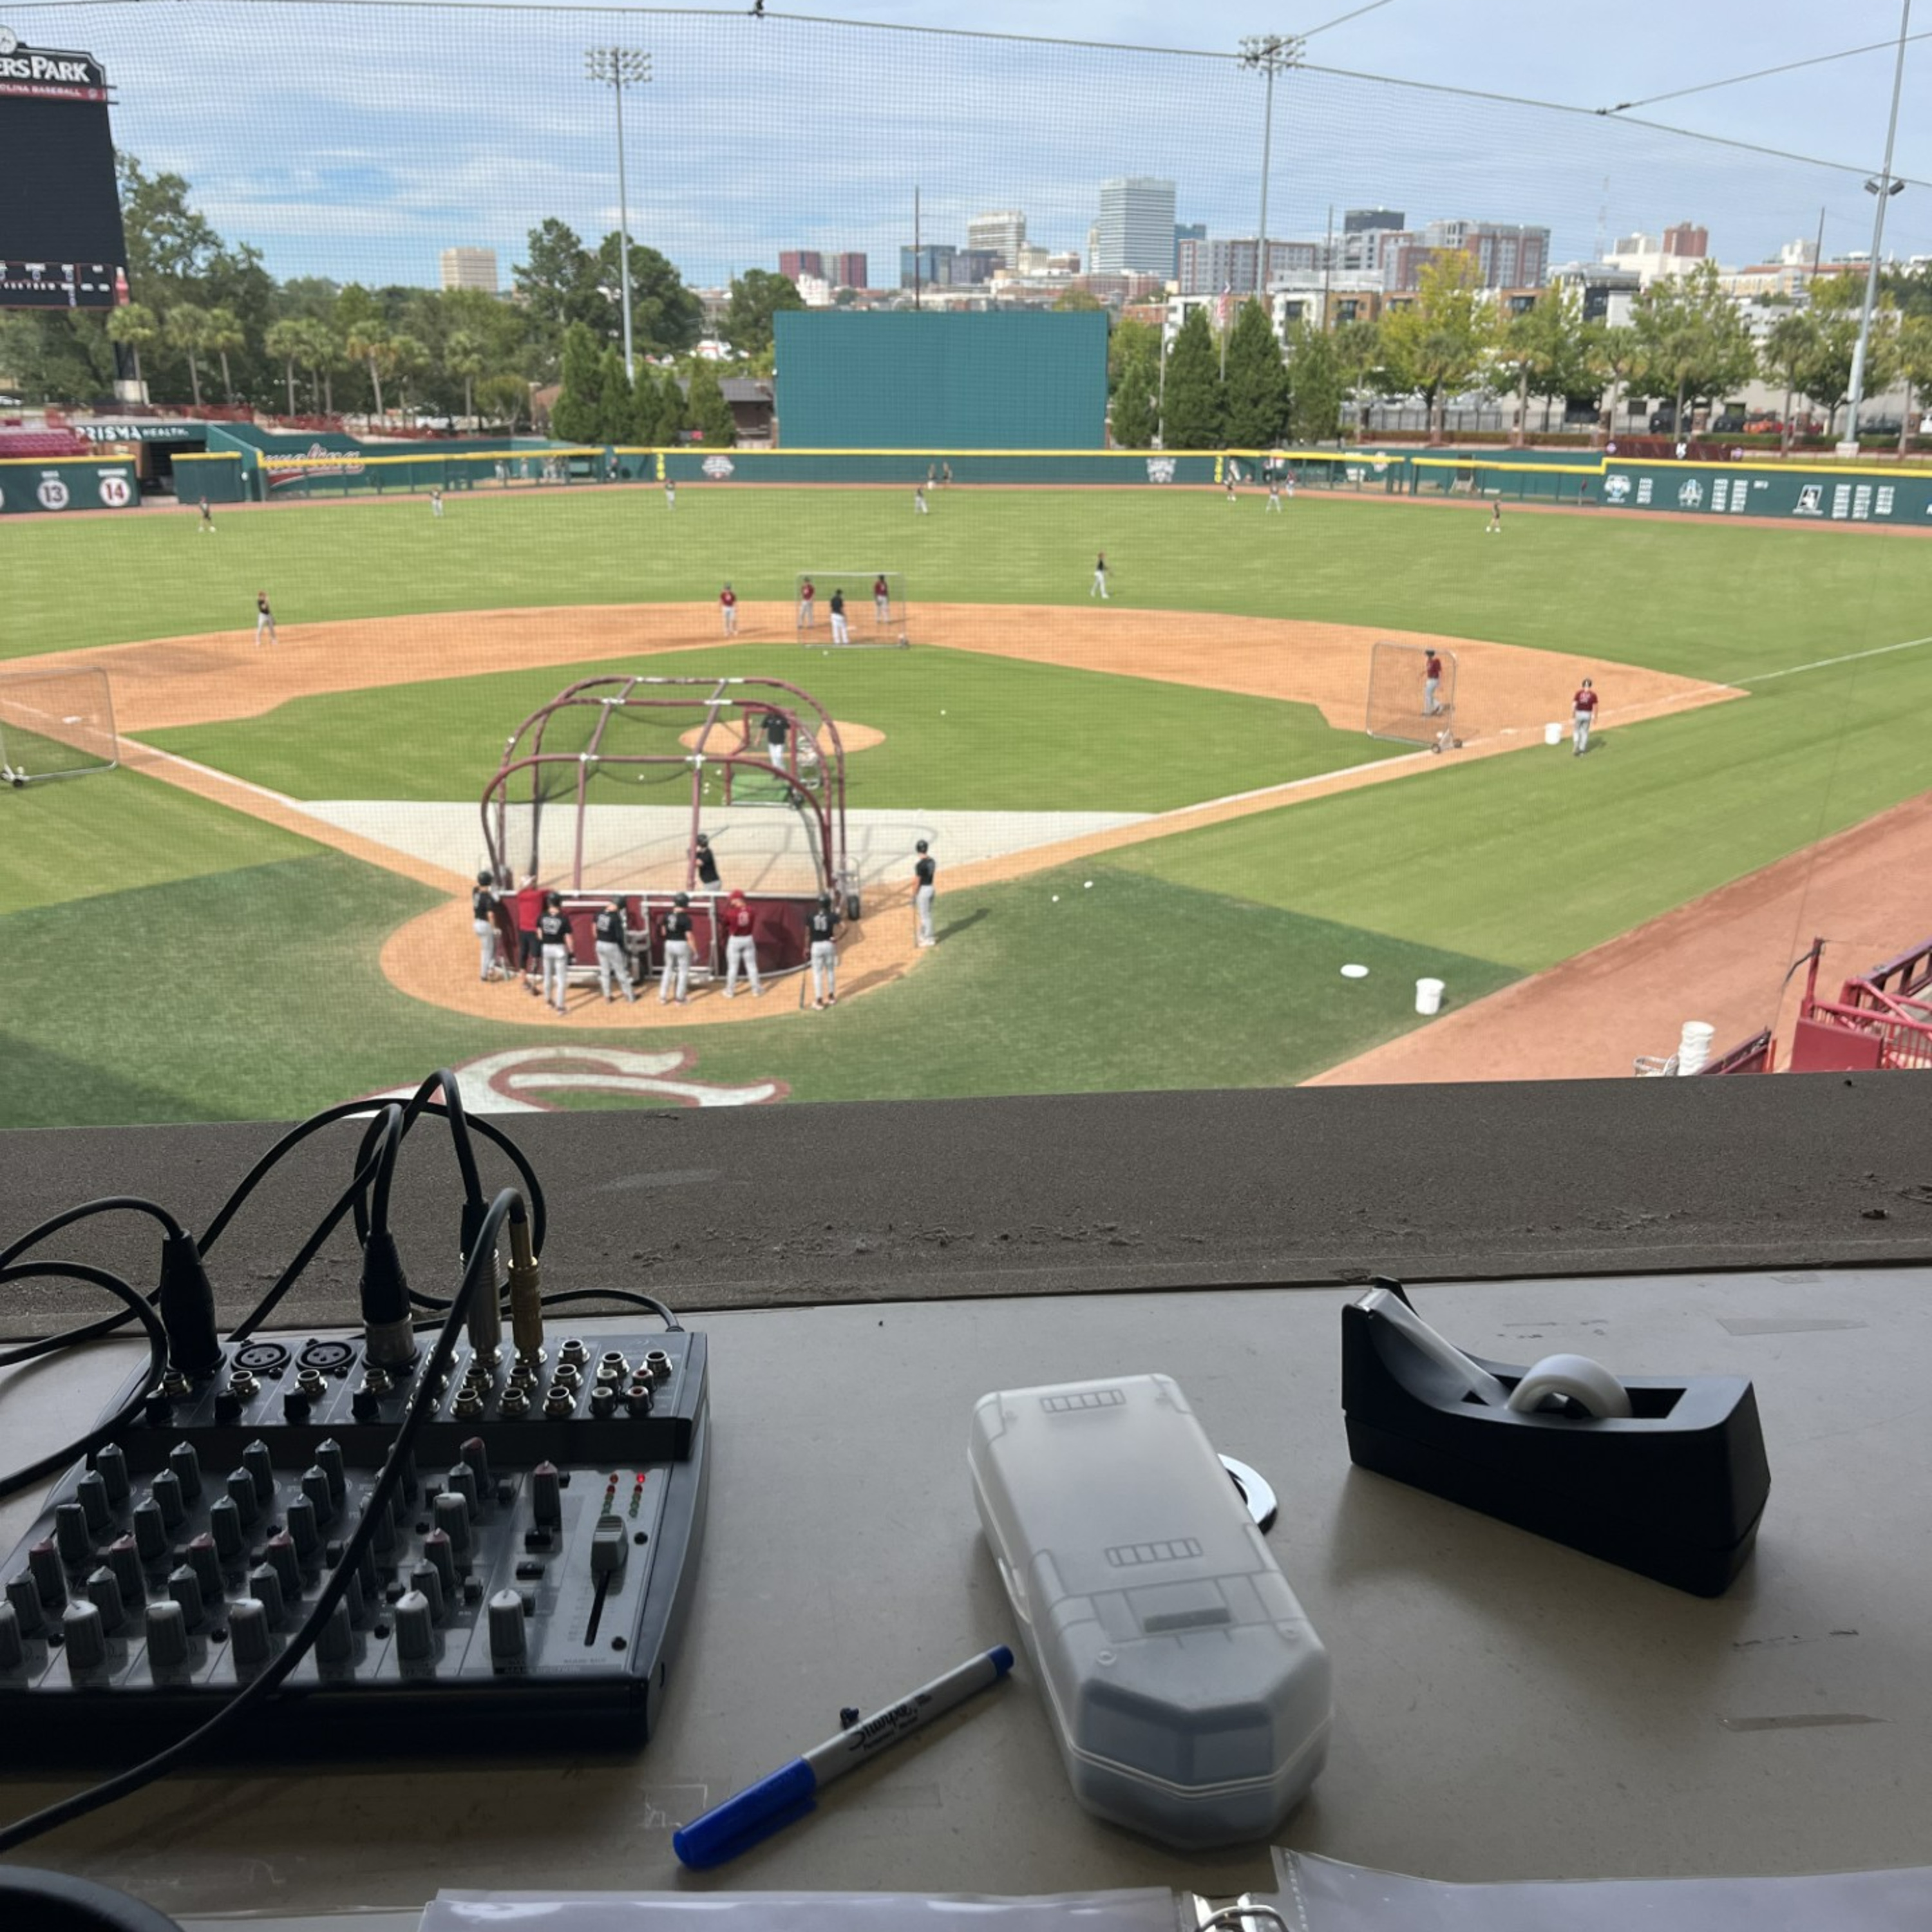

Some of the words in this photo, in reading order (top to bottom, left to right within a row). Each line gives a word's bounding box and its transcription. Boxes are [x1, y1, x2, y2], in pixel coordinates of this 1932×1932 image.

[32, 84, 82, 97] BASEBALL
[75, 425, 142, 441] PRISMA
[43, 485, 64, 502] 13
[106, 483, 124, 500] 14
